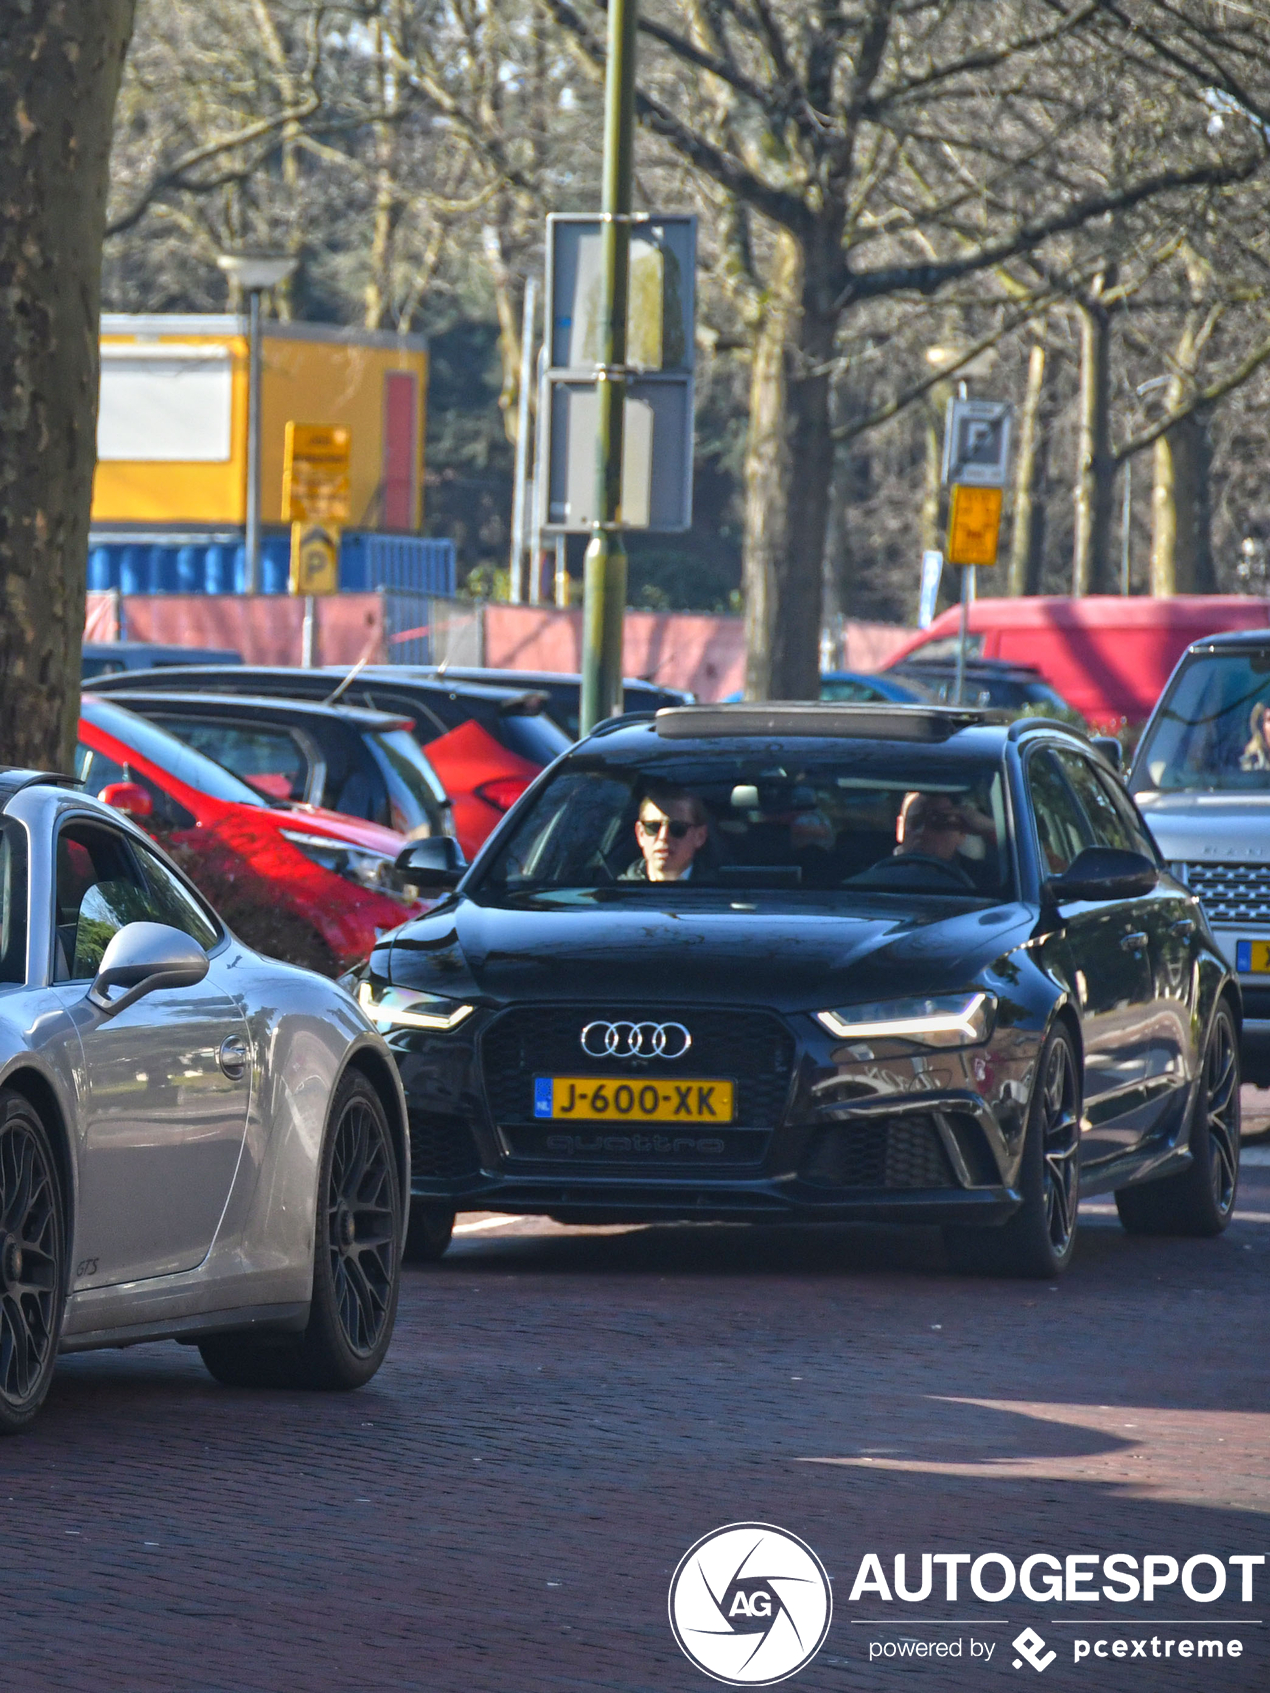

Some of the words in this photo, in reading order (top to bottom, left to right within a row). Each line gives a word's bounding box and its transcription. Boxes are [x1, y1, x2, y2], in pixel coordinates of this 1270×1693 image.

[537, 1101, 550, 1111] NL
[560, 1083, 717, 1116] J-600-XK
[547, 1134, 724, 1154] quattro
[77, 1257, 100, 1277] GTS
